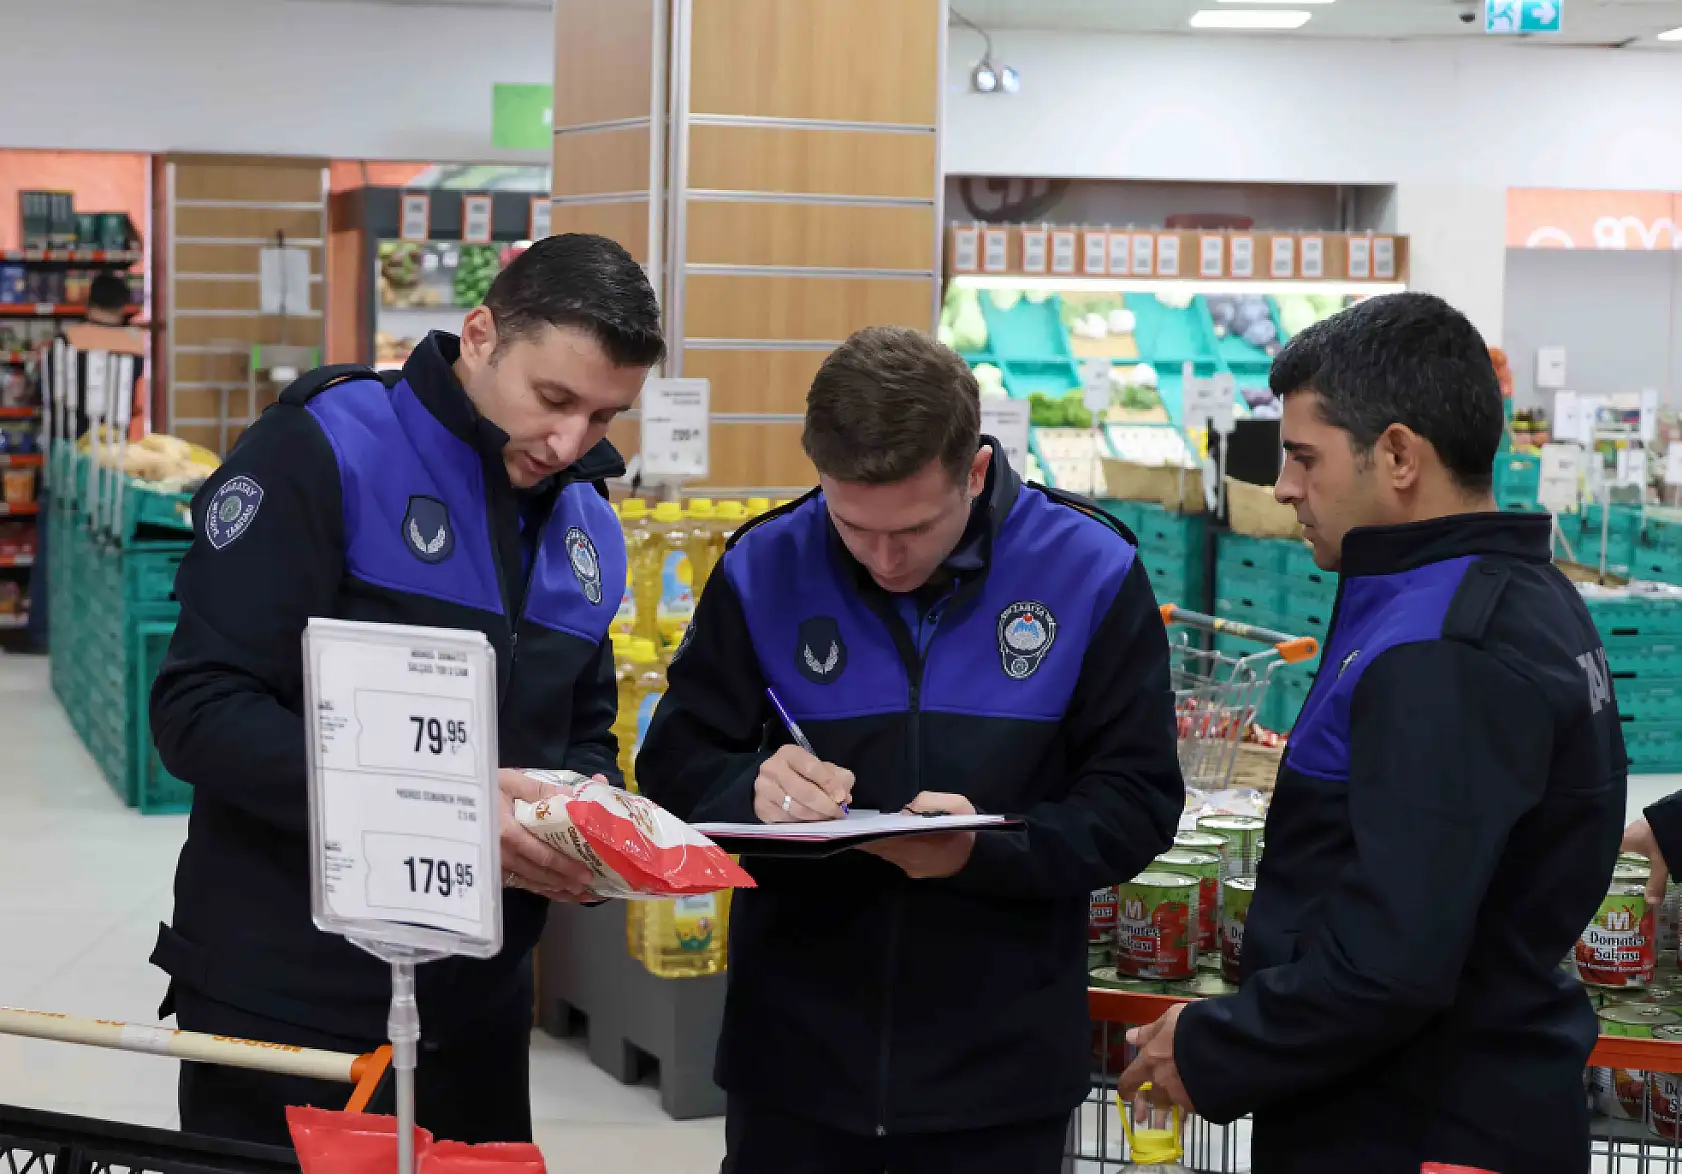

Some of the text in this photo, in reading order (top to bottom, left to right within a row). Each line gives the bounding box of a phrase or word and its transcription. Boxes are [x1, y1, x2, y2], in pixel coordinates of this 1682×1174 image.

[1125, 900, 1142, 920] M
[1607, 911, 1630, 930] M
[1590, 931, 1644, 946] Domates
